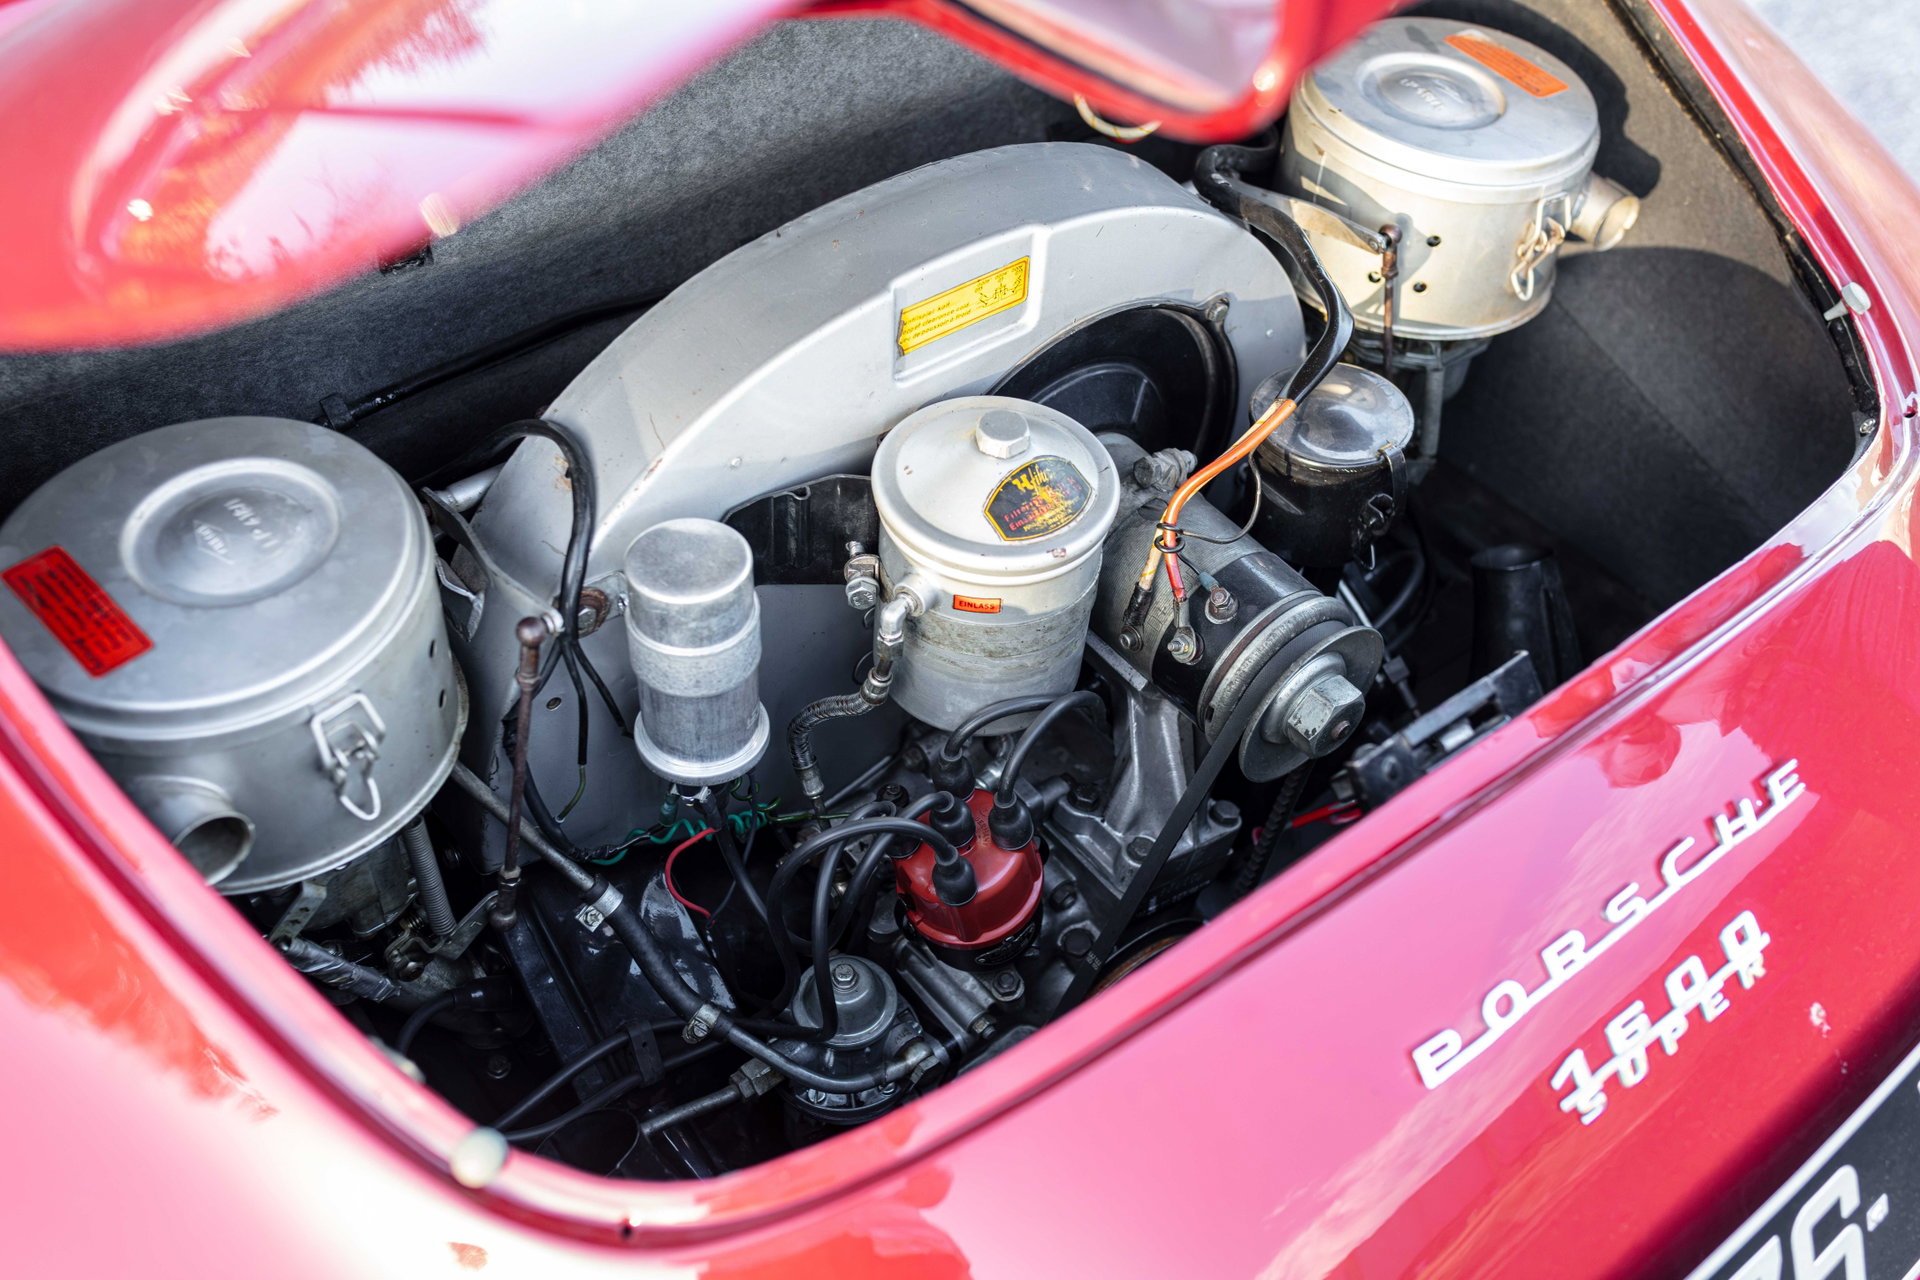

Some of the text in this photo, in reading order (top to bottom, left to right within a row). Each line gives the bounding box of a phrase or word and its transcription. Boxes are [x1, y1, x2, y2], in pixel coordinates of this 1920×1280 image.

[958, 600, 996, 610] EINLASS
[1413, 758, 1807, 1091] PORSCHE
[1550, 910, 1771, 1113] 1600
[1575, 951, 1767, 1126] SUPER
